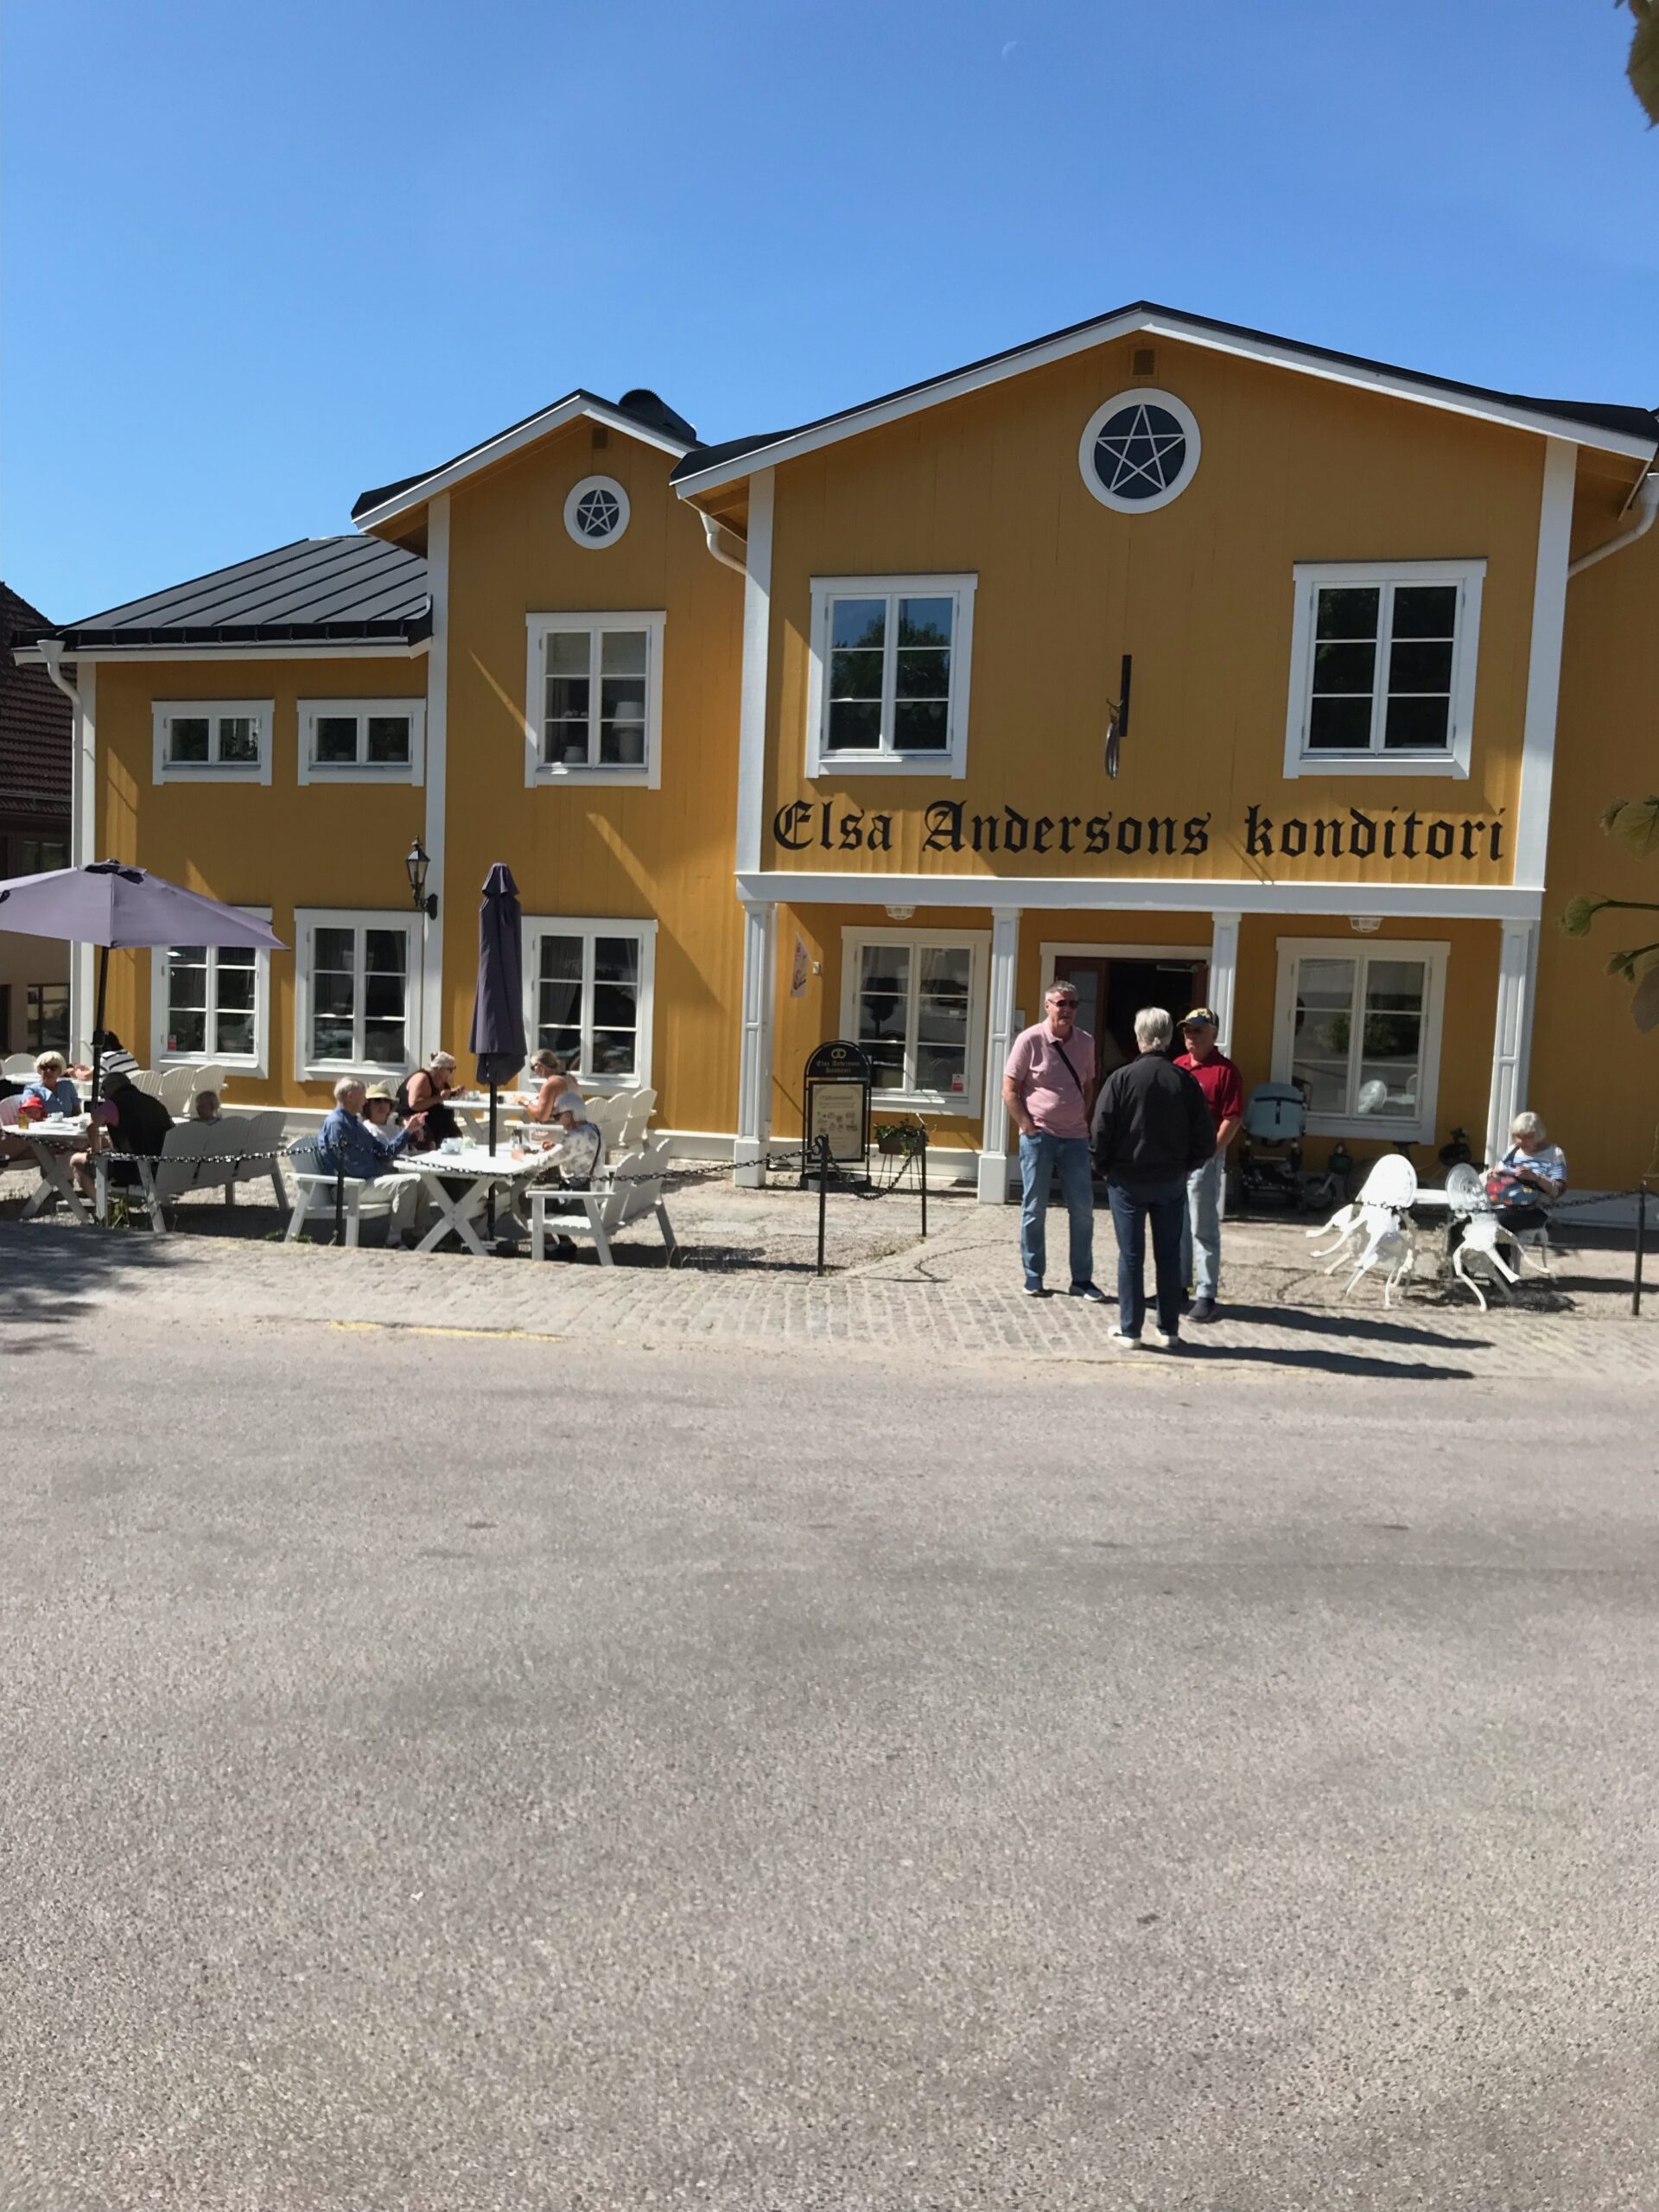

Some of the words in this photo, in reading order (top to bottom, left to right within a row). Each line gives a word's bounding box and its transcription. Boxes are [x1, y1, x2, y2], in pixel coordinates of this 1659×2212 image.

[773, 799, 893, 852] Elsa
[921, 799, 1212, 856] Andersons
[1244, 804, 1505, 861] konditori
